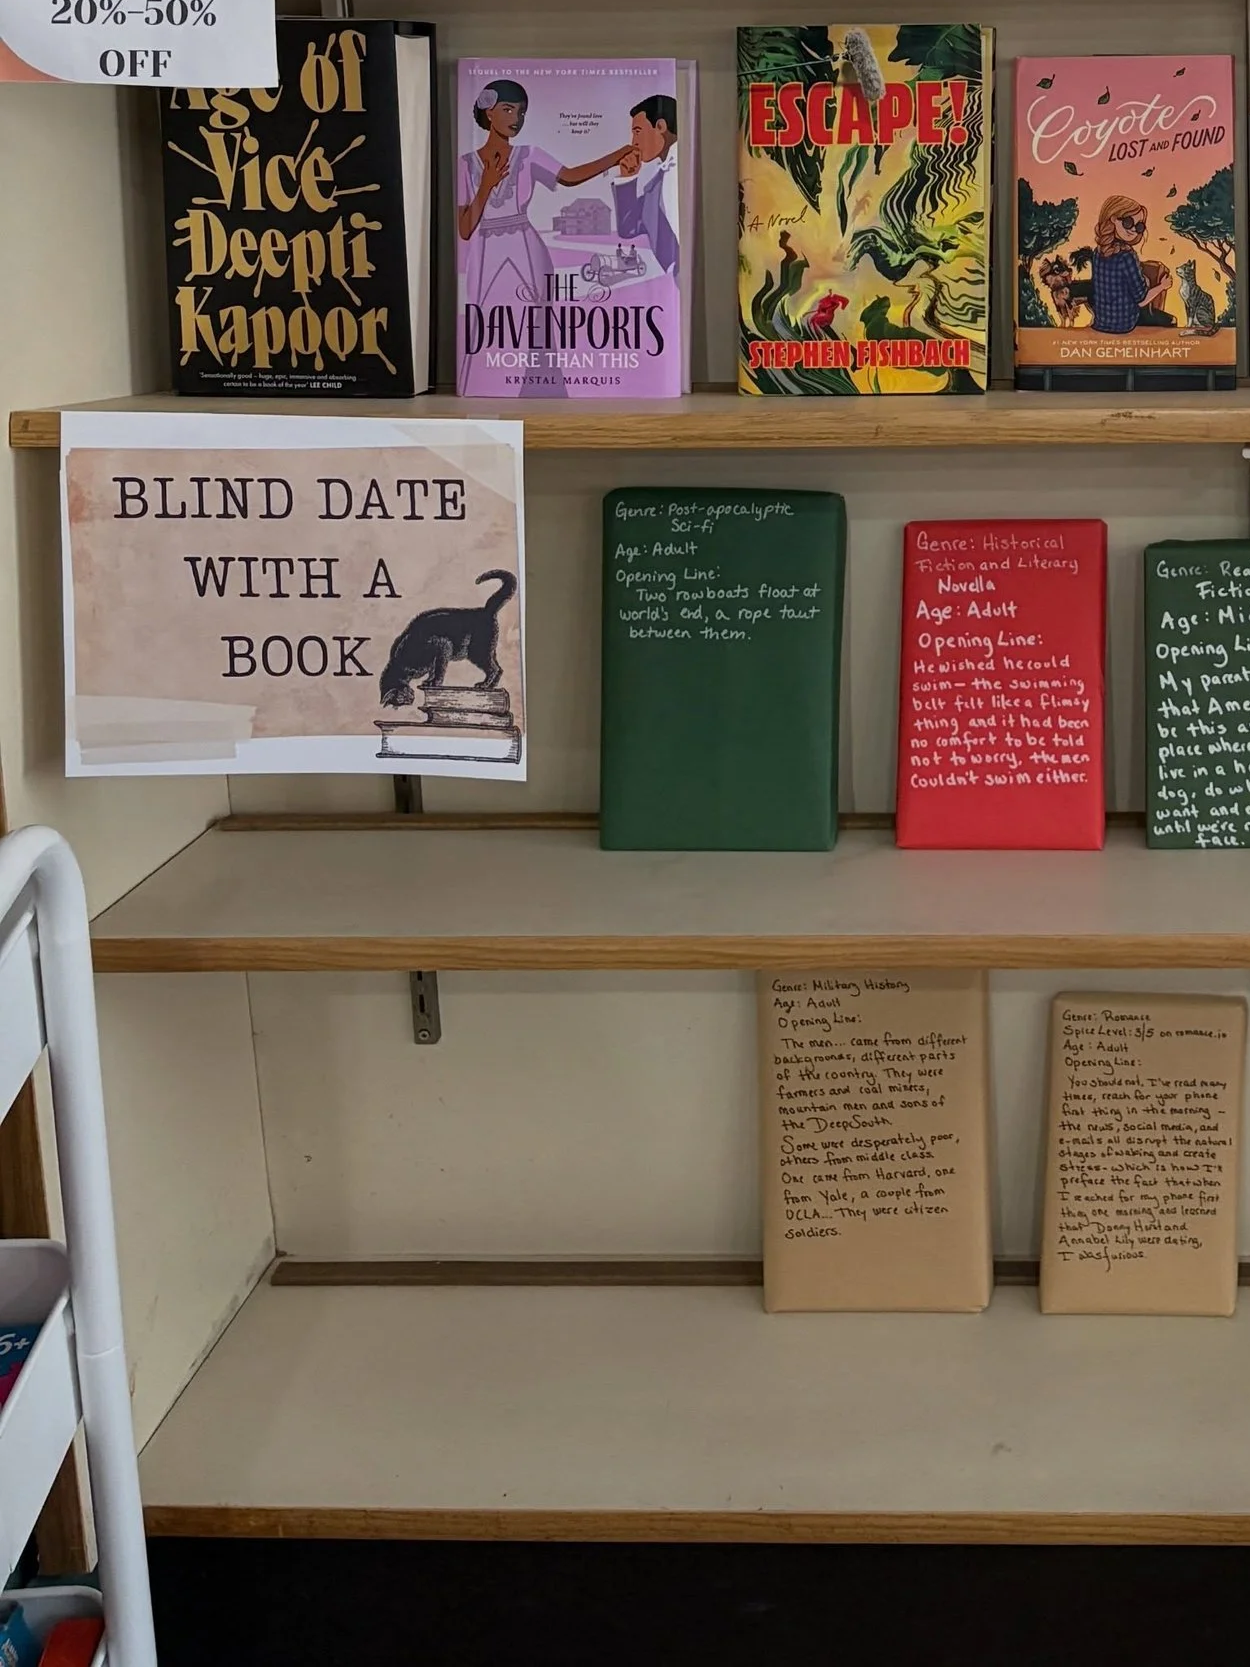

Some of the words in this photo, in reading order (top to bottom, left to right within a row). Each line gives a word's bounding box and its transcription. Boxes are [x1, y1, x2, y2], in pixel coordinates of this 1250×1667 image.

[99, 49, 172, 78] OFF
[749, 81, 971, 147] ESCAPE!
[1027, 94, 1217, 164] Coyote
[1108, 140, 1146, 162] LOST
[1150, 141, 1170, 152] AND
[1171, 126, 1226, 152] FOUND
[191, 126, 338, 213] Vice
[180, 210, 377, 294] Deepti
[544, 272, 580, 302] THE
[176, 286, 389, 370] Kapoor
[464, 303, 664, 357] DAVENPORTS
[486, 352, 540, 369] MORE
[545, 353, 595, 369] THAN
[599, 353, 639, 369] THIS
[749, 340, 850, 368] STEPHEN
[857, 338, 970, 368] FISHBACH
[1060, 346, 1092, 358] DAN
[1096, 346, 1192, 358] GEMEINHART
[113, 477, 293, 519] BLIND
[317, 478, 466, 521] DATE
[615, 502, 663, 520] Genre:
[669, 502, 794, 521] Post-apocalyptic
[672, 519, 714, 533] Sci-fi
[615, 543, 648, 562] Age:
[652, 542, 698, 556] Adult
[983, 534, 1064, 551] Historical
[184, 556, 341, 598] WITH
[363, 558, 401, 598] A
[616, 570, 676, 590] Opening
[684, 566, 720, 579] Line:
[938, 577, 996, 594] Novella
[637, 589, 666, 602] Two
[677, 585, 749, 600] rowboats
[758, 584, 799, 598] float
[803, 583, 820, 598] at
[620, 606, 669, 621] world's
[680, 605, 709, 623] end,
[716, 609, 730, 619] a
[739, 609, 771, 623] rope
[780, 606, 820, 619] taut
[629, 626, 691, 638] between
[700, 627, 751, 640] them.
[221, 635, 373, 678] BOOK
[813, 979, 860, 996] Military
[865, 979, 910, 992] History
